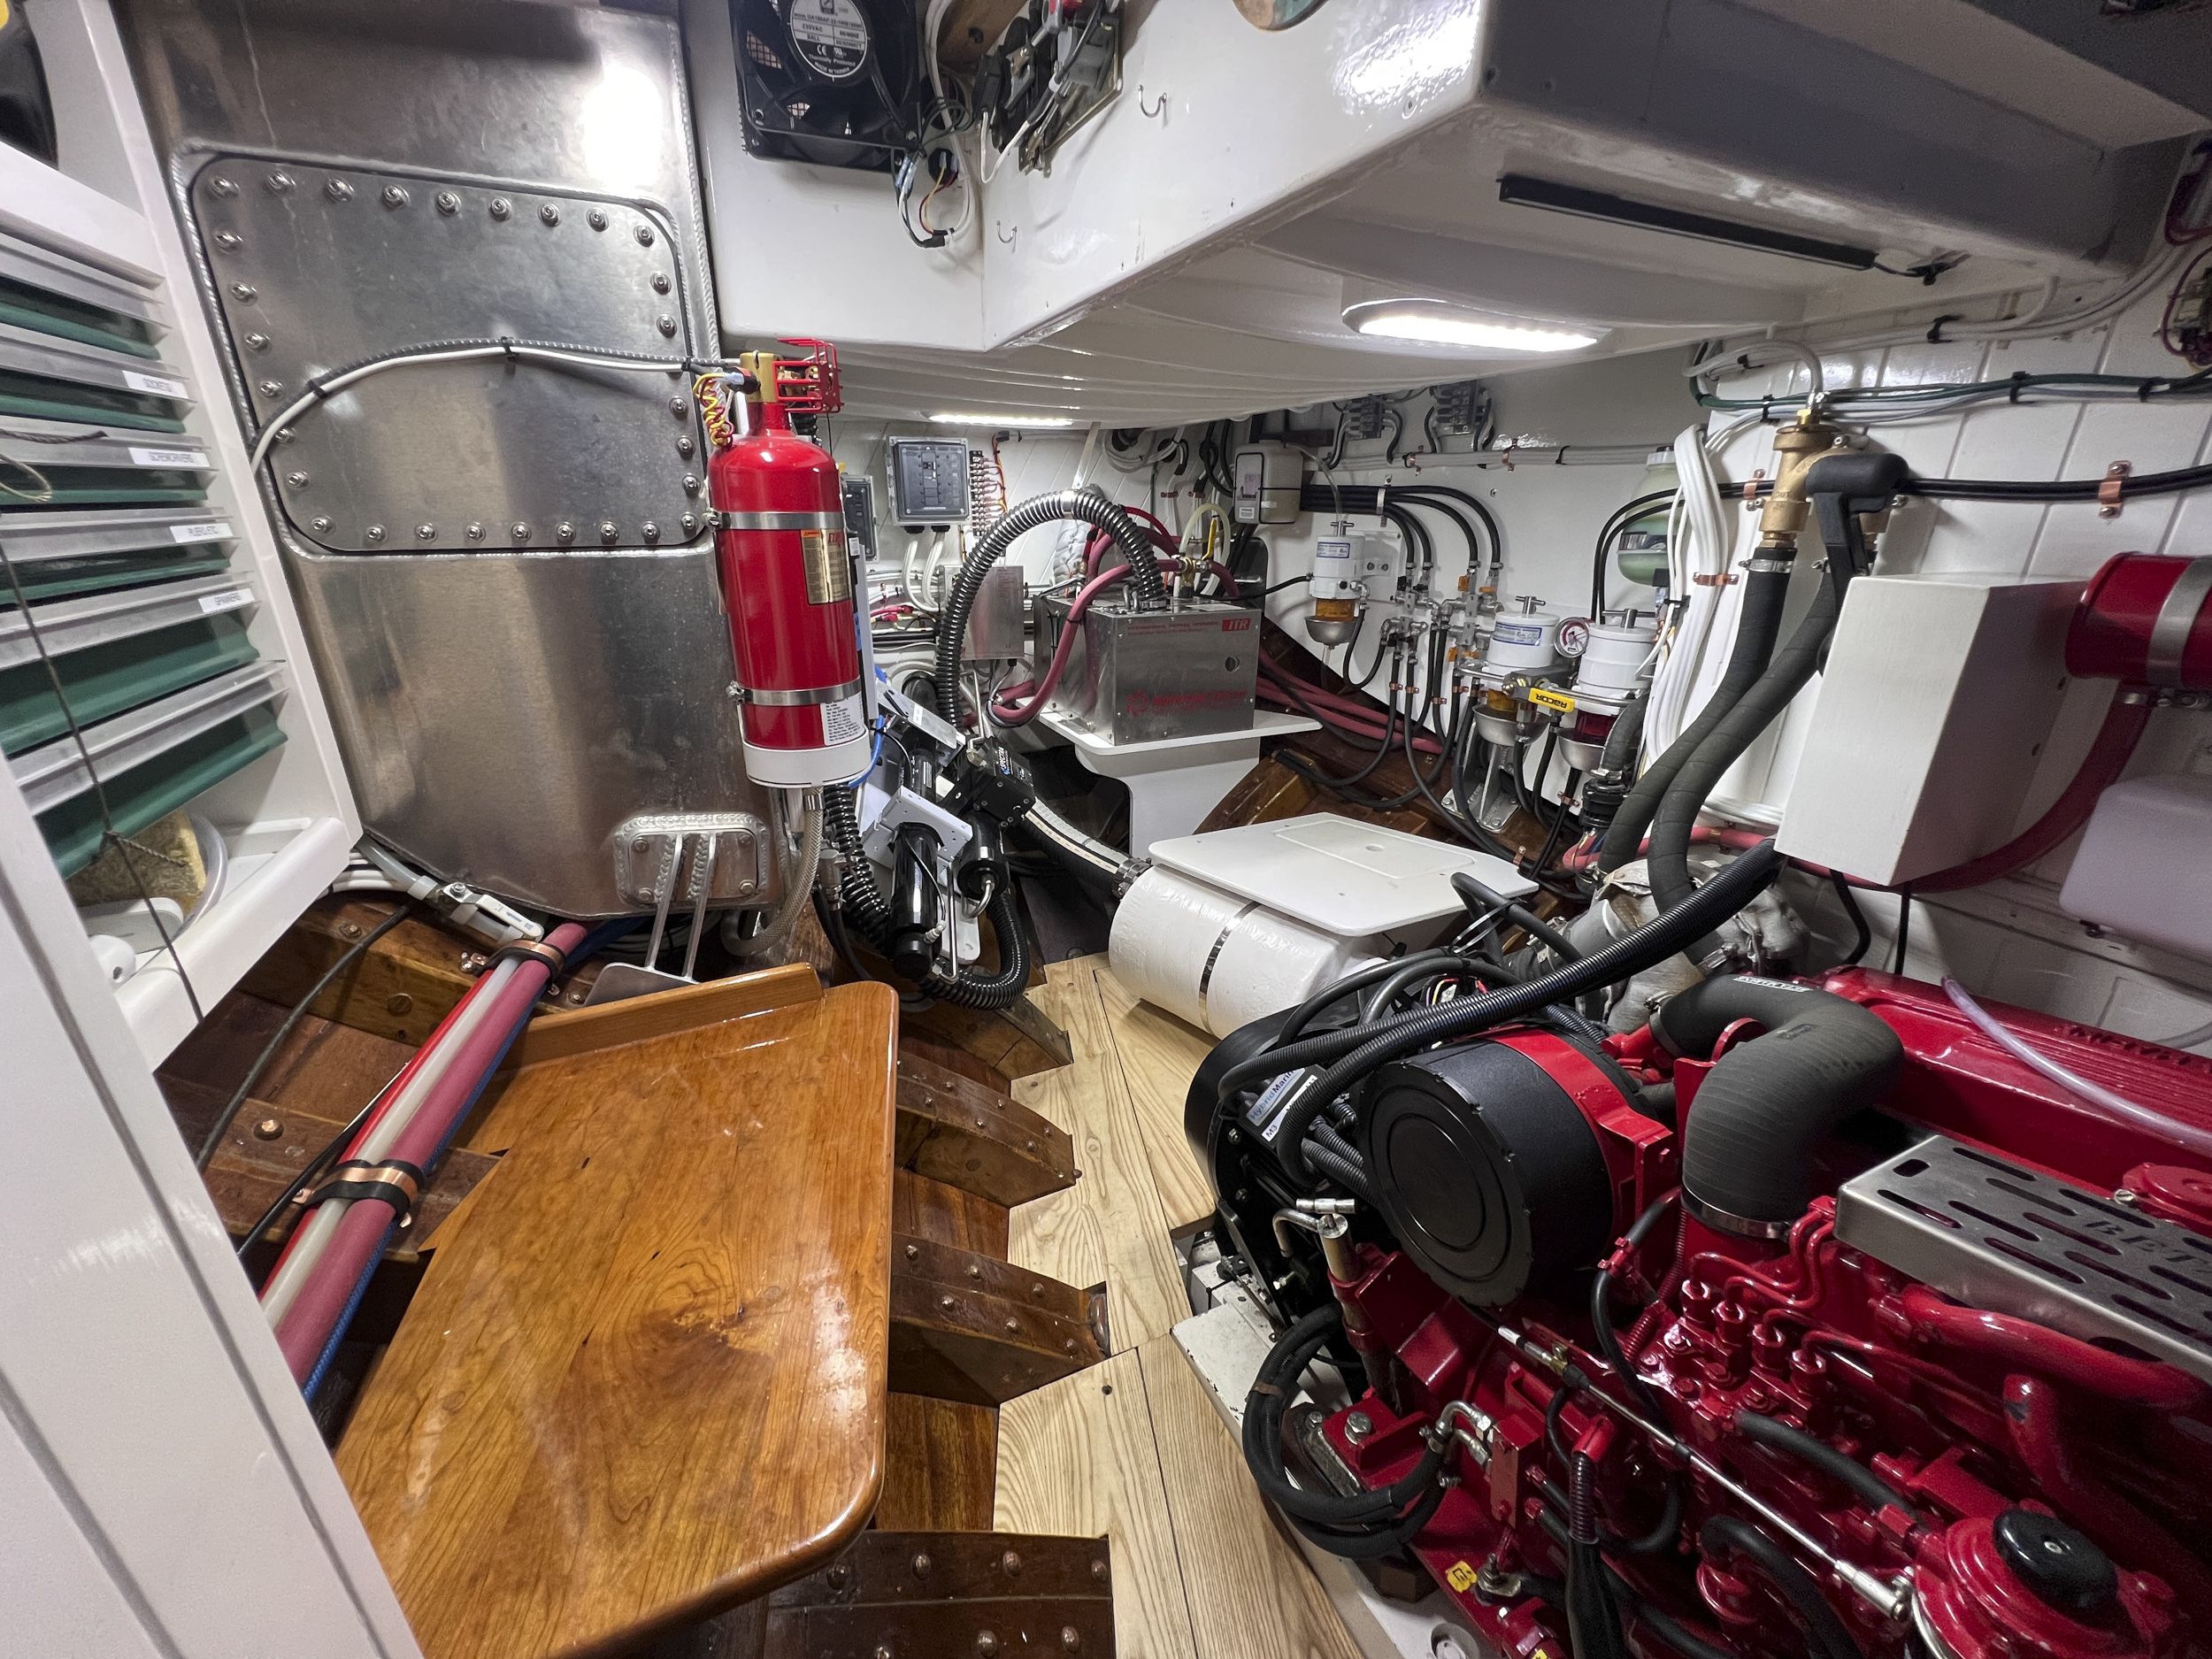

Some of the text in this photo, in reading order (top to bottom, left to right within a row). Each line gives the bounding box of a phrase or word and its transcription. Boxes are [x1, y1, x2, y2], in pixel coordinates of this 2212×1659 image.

[1228, 620, 1248, 631] ITR
[1249, 1070, 1294, 1120] HybridMarin
[1265, 1125, 1278, 1138] M3
[2083, 1220, 2212, 1274] BET
